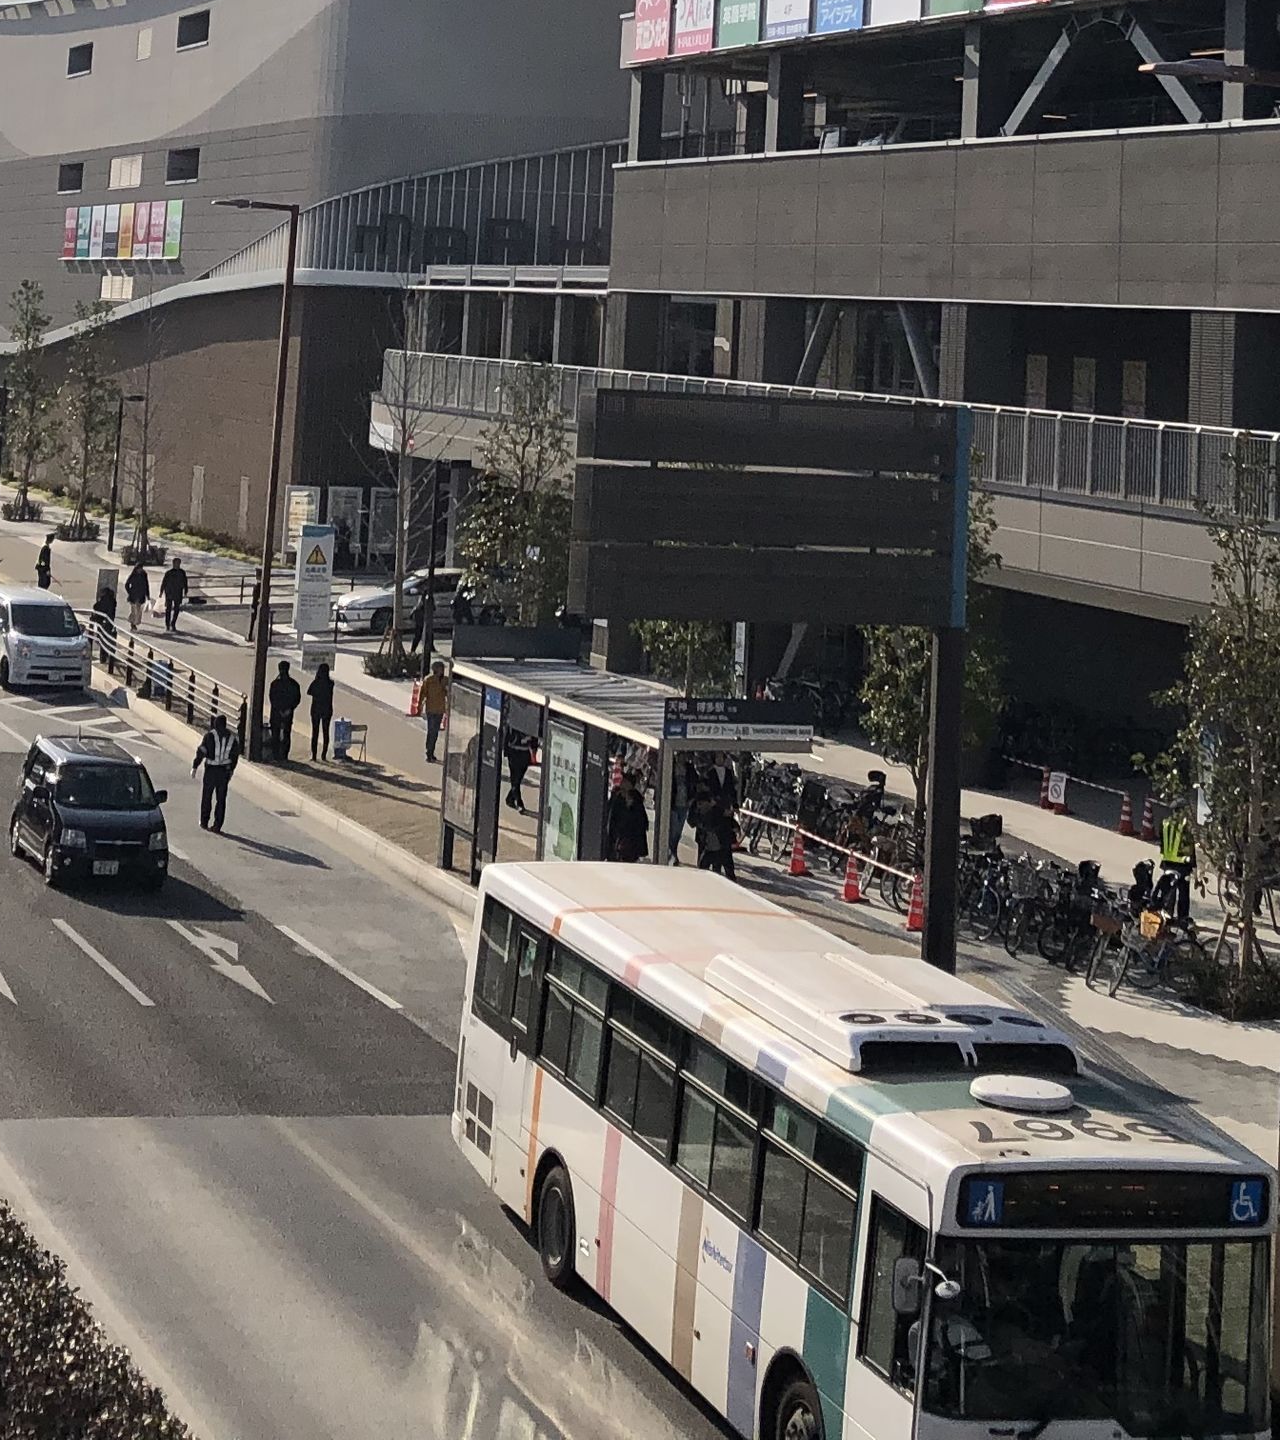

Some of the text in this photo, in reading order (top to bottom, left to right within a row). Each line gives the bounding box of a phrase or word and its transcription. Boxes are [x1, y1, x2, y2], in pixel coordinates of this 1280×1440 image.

[820, 5, 858, 27] アイシティ
[668, 700, 688, 712] 天神
